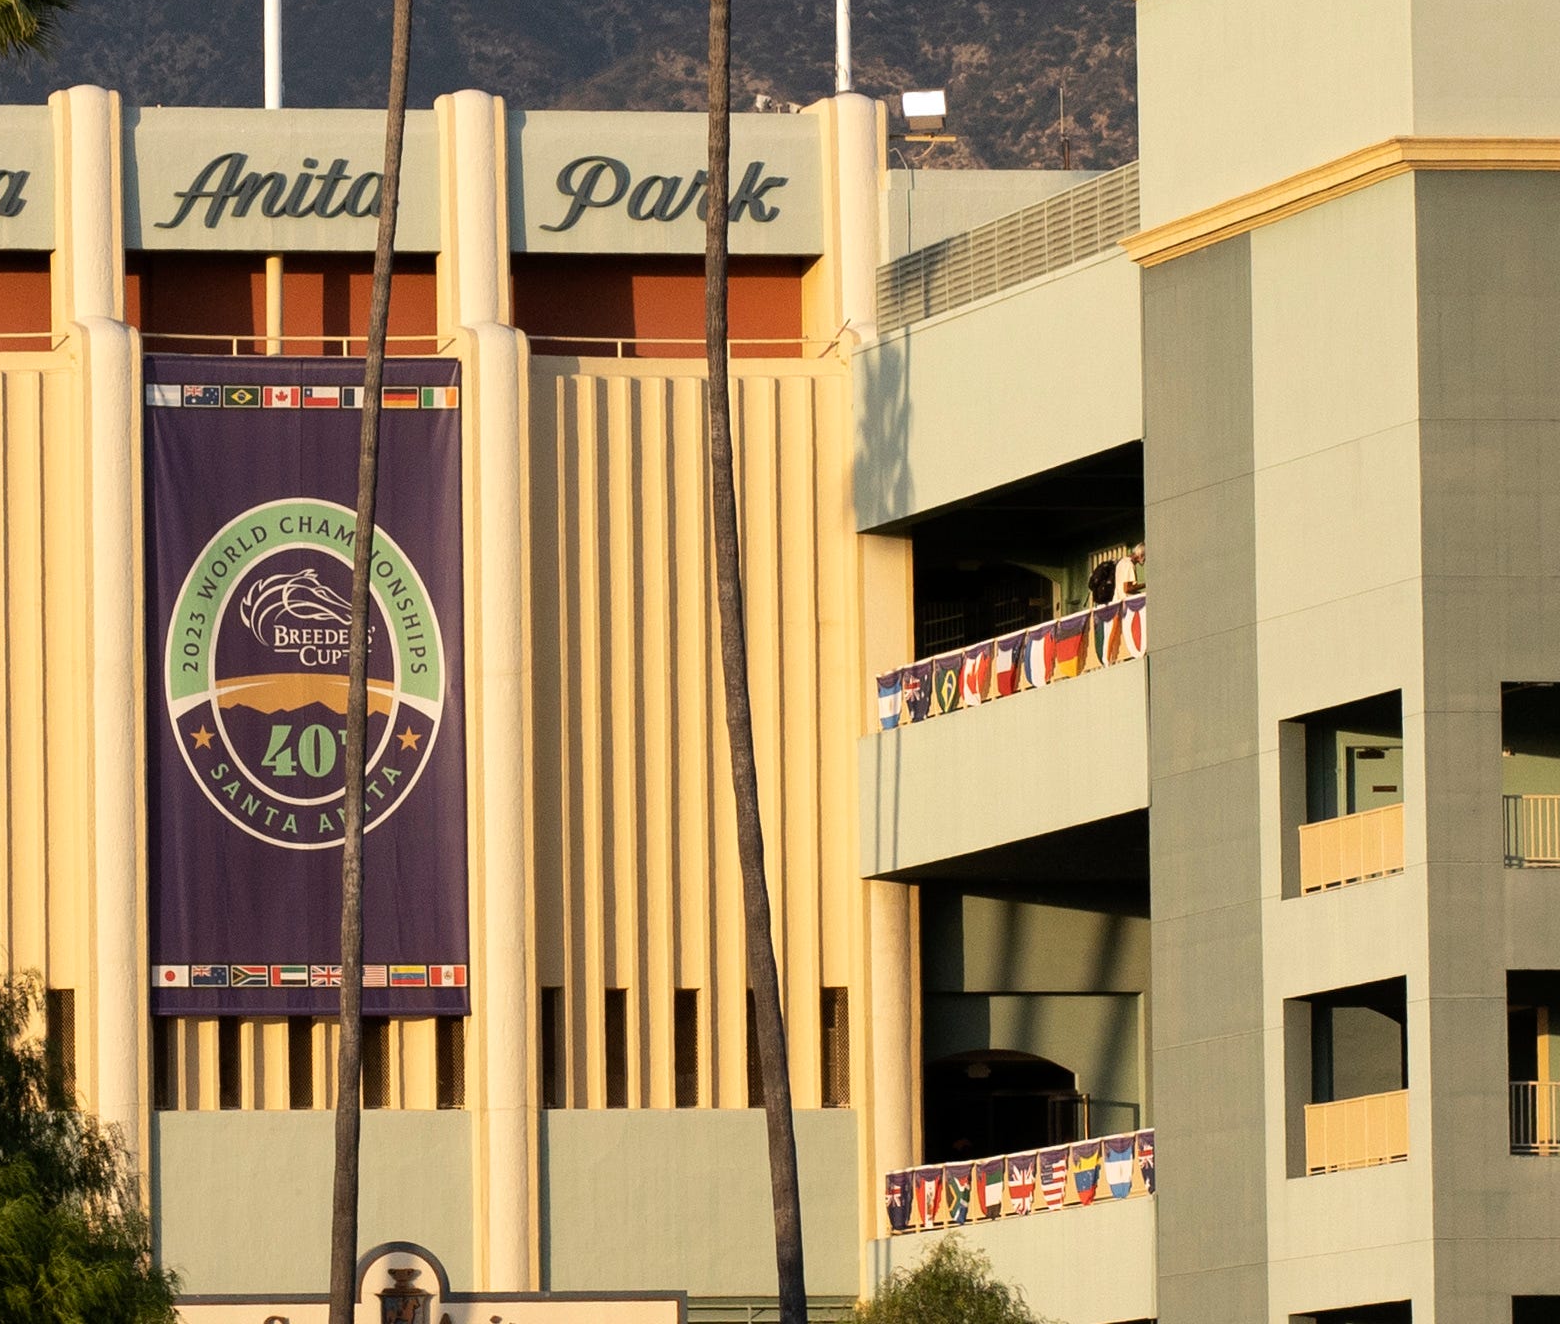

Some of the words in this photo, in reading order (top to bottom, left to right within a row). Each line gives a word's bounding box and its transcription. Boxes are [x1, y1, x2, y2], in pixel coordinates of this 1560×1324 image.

[153, 152, 386, 229] Anita
[182, 611, 206, 673] 2023
[197, 525, 269, 601] WORLD
[279, 515, 428, 674] CHAMIONSHIPS
[273, 625, 376, 647] BREEDE'
[210, 762, 298, 834] SANTA
[318, 765, 403, 834] ATA
